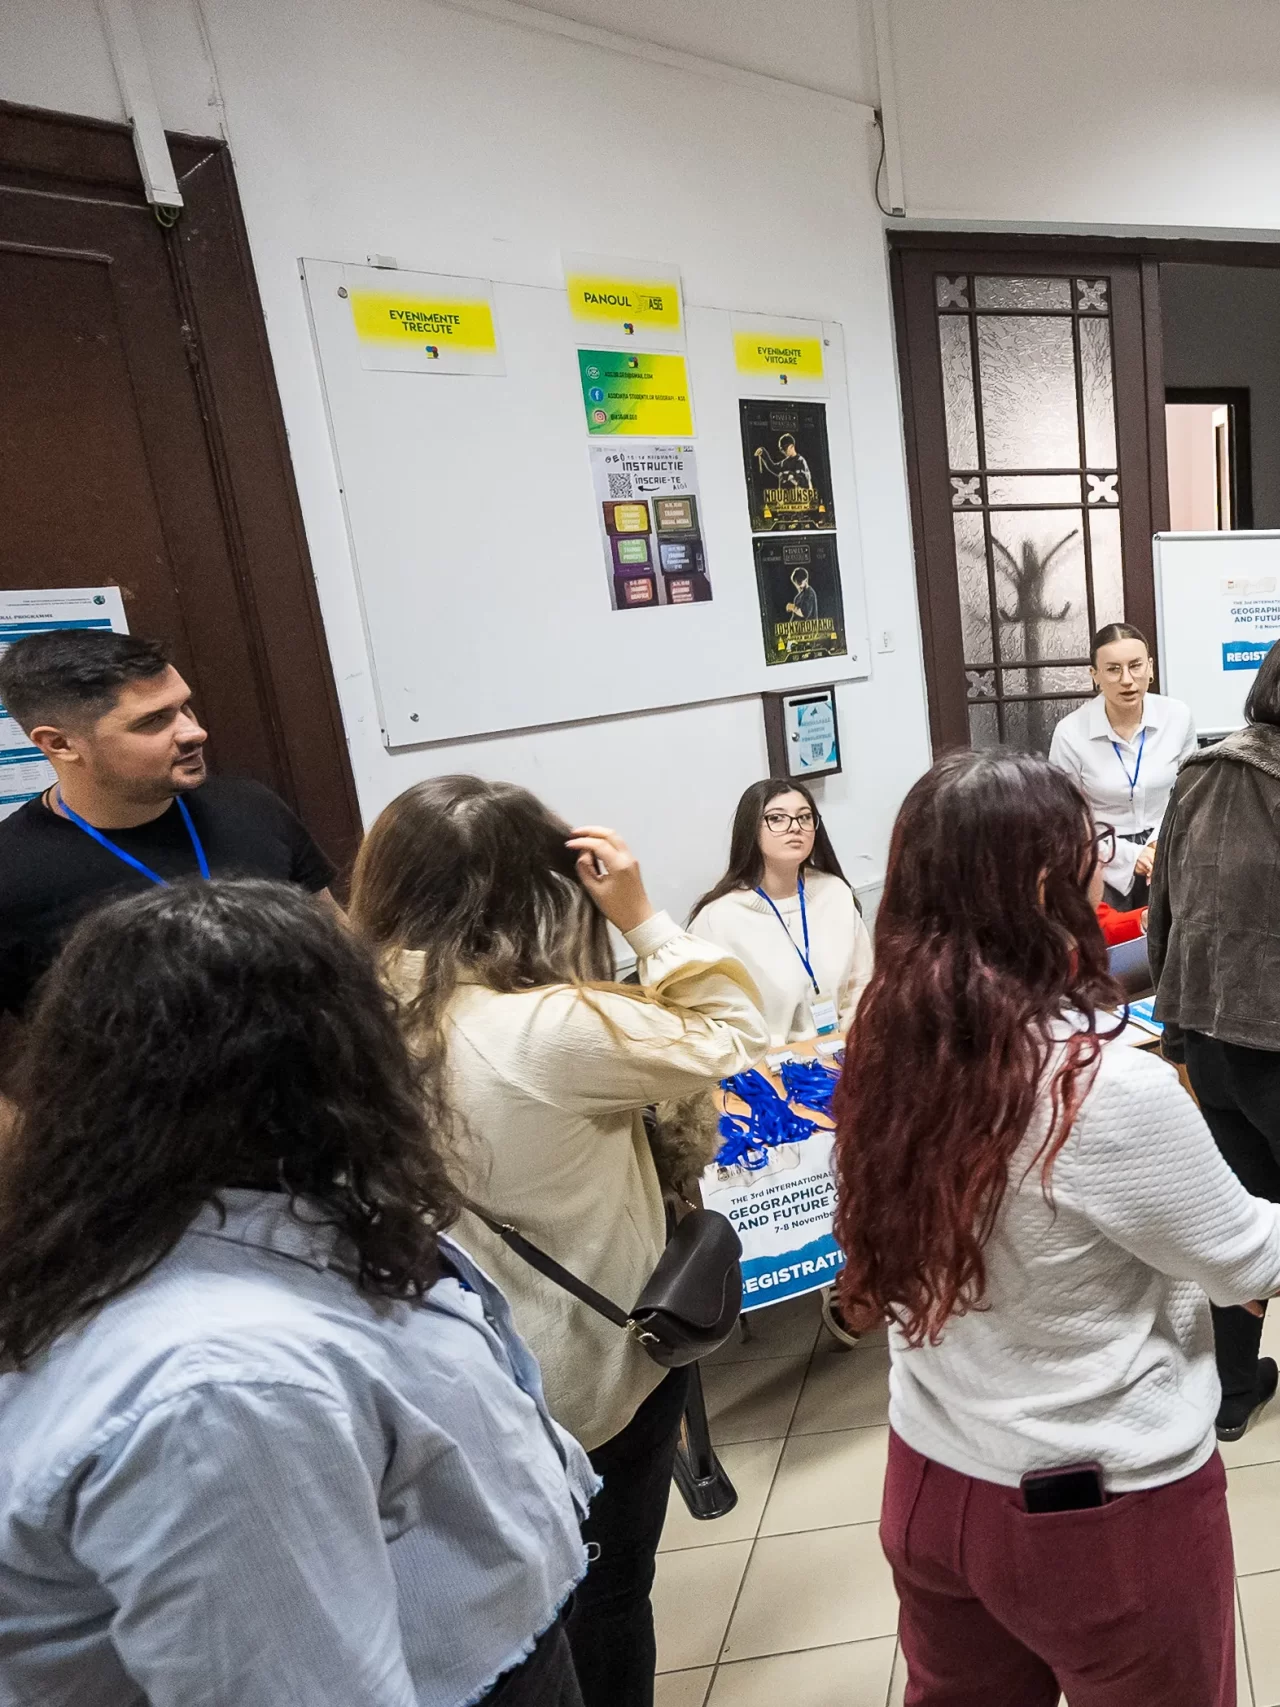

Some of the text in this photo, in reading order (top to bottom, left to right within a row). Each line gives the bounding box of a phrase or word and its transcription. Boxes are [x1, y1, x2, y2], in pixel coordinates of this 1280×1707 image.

[584, 292, 632, 307] PANOUL
[389, 309, 460, 324] EVENIMENTE
[402, 321, 453, 334] TRECUTE
[757, 346, 801, 357] EVENIMENTE
[765, 356, 798, 365] VIITOARE
[1234, 615, 1253, 623] AND
[1226, 652, 1267, 662] REGIST
[729, 1182, 836, 1220] GEOGRAPHICA
[731, 1195, 748, 1205] THE
[751, 1189, 764, 1200] 3rd
[737, 1215, 769, 1232] AND
[773, 1196, 829, 1221] FUTURE
[774, 1211, 836, 1233] 7-8 Novembe
[742, 1250, 847, 1294] EGISTRATI
